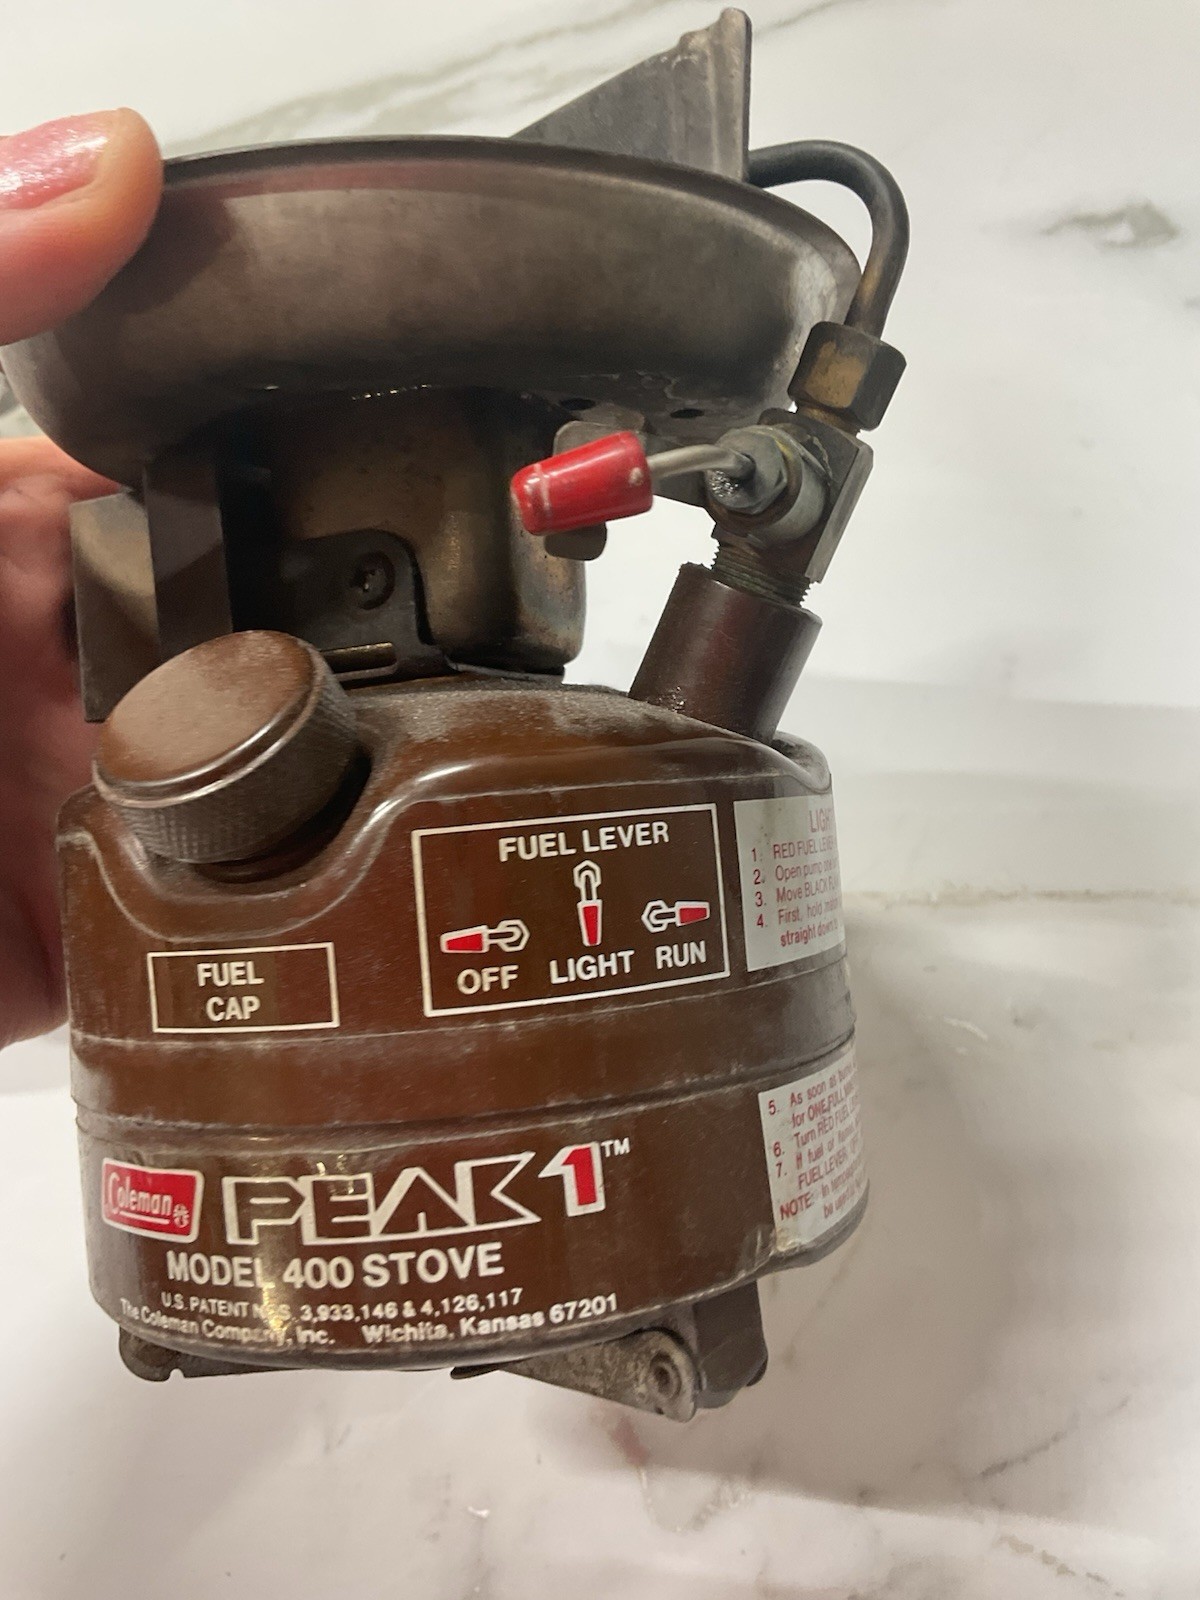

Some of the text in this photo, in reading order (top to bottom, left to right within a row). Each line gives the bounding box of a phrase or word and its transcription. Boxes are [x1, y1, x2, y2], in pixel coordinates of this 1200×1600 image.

[499, 821, 670, 862] FUEL LEVER
[773, 843, 796, 859] RED
[797, 839, 817, 855] FUEL
[775, 864, 802, 882] Open
[776, 887, 803, 904] Move
[807, 901, 823, 918] hold
[780, 925, 818, 948] straight
[196, 961, 265, 987] FUEL
[457, 941, 707, 995] OFF LIGHT RUN
[205, 995, 261, 1021] CAP
[789, 1092, 803, 1108] As
[807, 1081, 827, 1100] soon
[791, 1112, 805, 1129] for
[807, 1098, 827, 1121] ONE
[793, 1128, 816, 1149] Turn
[817, 1115, 834, 1138] RED
[798, 1164, 824, 1190] FUEL
[107, 1171, 174, 1216] Coleman
[221, 1151, 543, 1246] PEAK
[166, 1241, 506, 1289] MODEL 400 STOVE
[161, 1291, 188, 1311] U.S.
[189, 1299, 250, 1319] PATENT
[300, 1301, 399, 1324] 3,933,146
[402, 1300, 417, 1318] &
[420, 1286, 524, 1318] 4,126,117
[459, 1309, 546, 1338] Kansas
[549, 1292, 619, 1325] 67201
[119, 1297, 140, 1320] The
[140, 1306, 200, 1335] Coleman
[296, 1324, 336, 1345] Inc.
